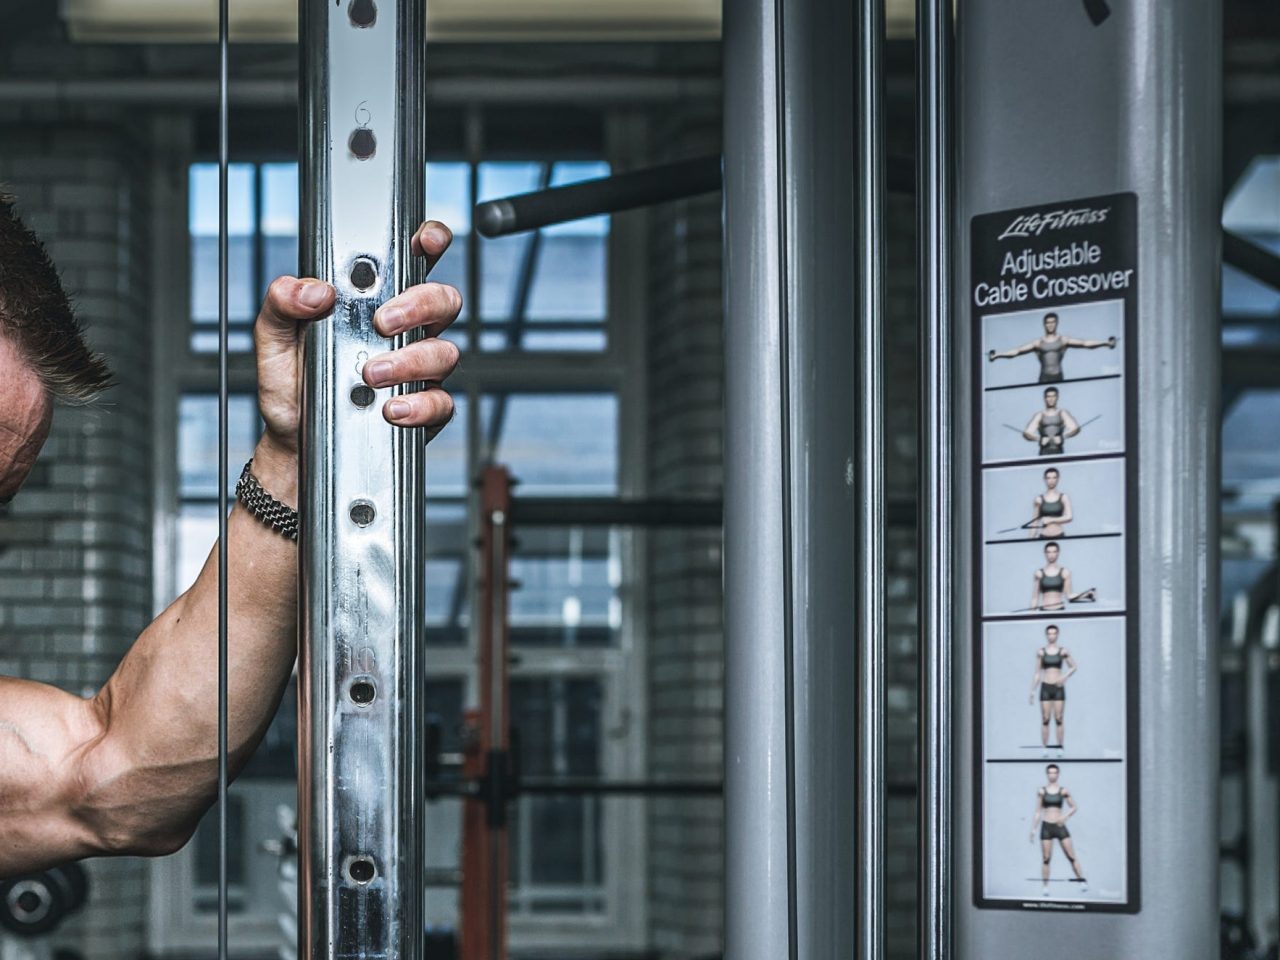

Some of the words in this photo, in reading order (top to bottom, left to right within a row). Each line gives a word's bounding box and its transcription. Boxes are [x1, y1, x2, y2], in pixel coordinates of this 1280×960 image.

[1000, 241, 1101, 279] Adjustable
[974, 278, 1028, 307] Cable
[1032, 269, 1134, 299] Crossover
